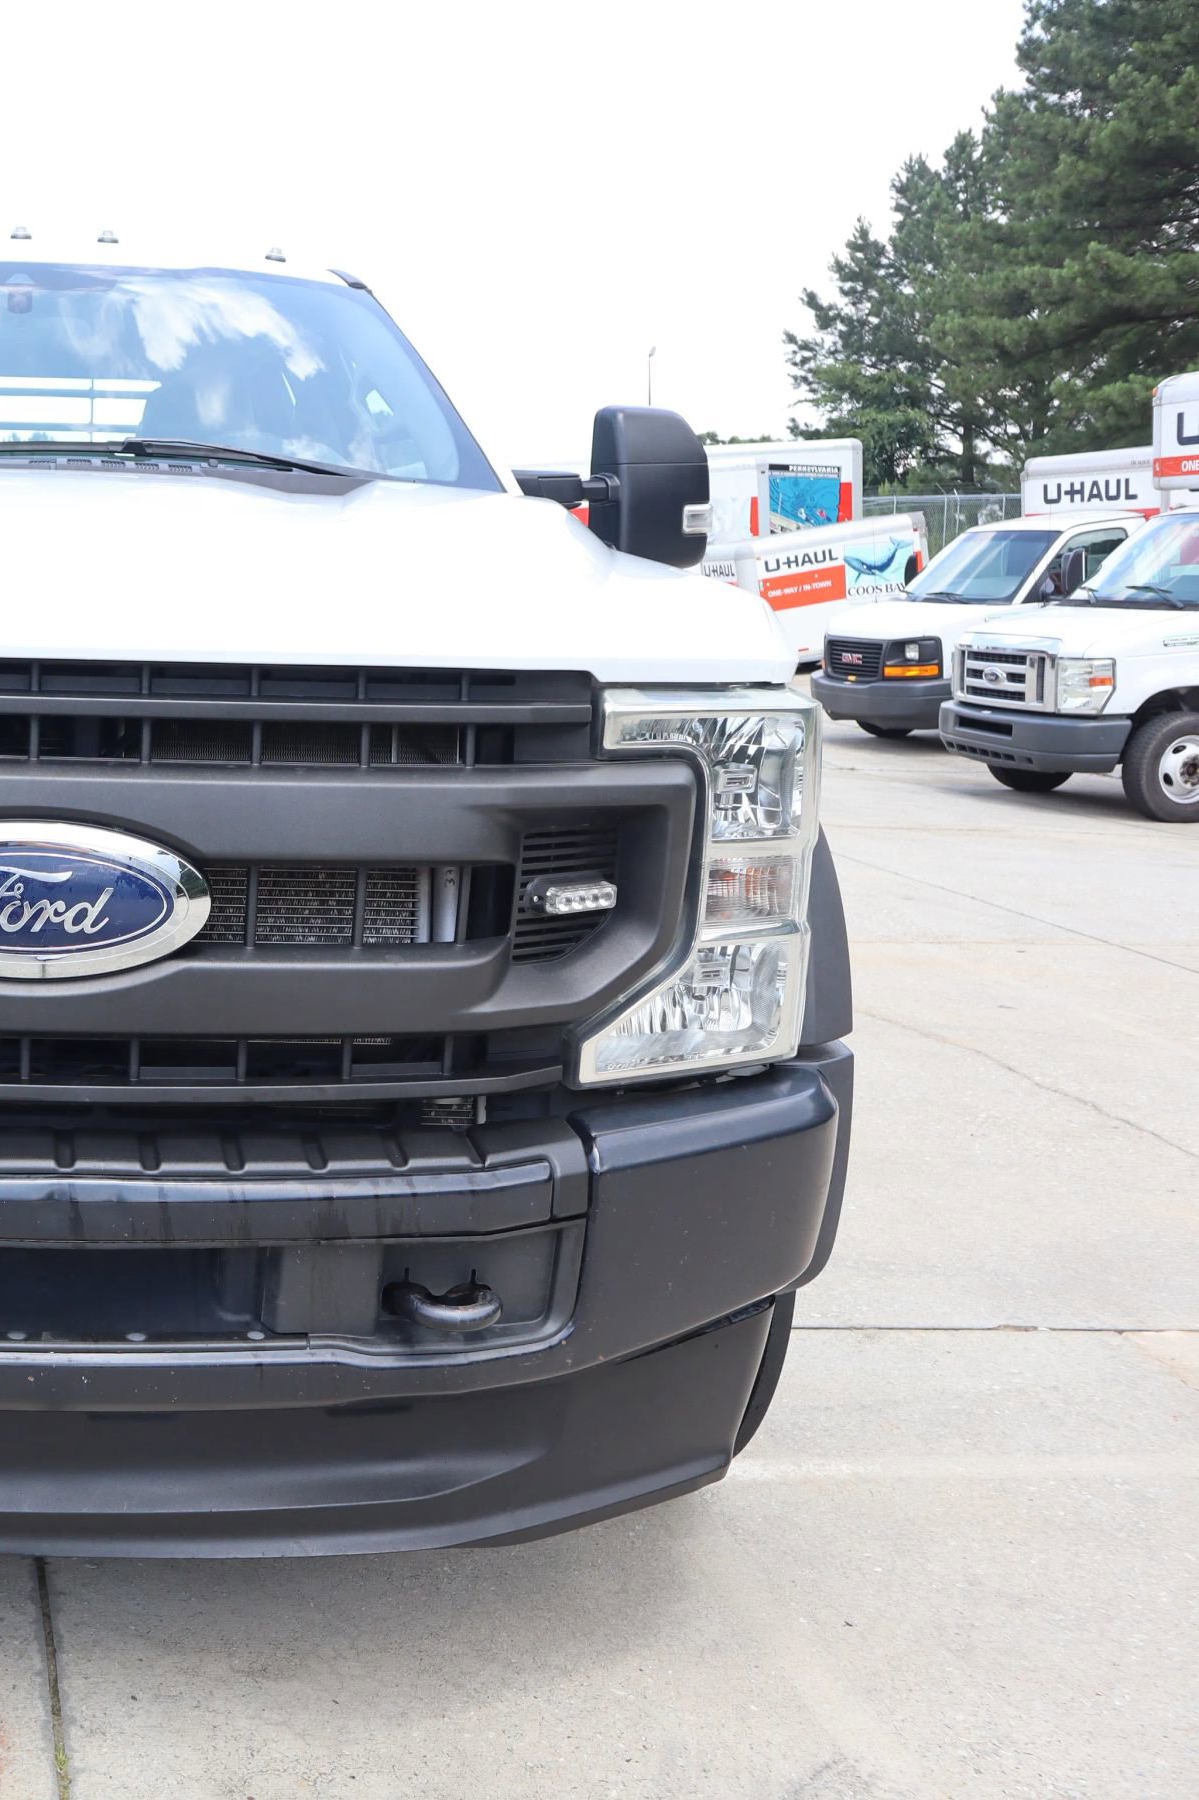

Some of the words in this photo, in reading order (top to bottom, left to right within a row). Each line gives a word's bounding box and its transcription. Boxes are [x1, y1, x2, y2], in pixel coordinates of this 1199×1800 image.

[788, 464, 839, 473] PENNSYLVANIA
[1043, 478, 1138, 504] U-HAUL
[764, 548, 839, 573] U-HAUL
[704, 563, 735, 577] U-HAUL
[847, 584, 883, 597] COOS
